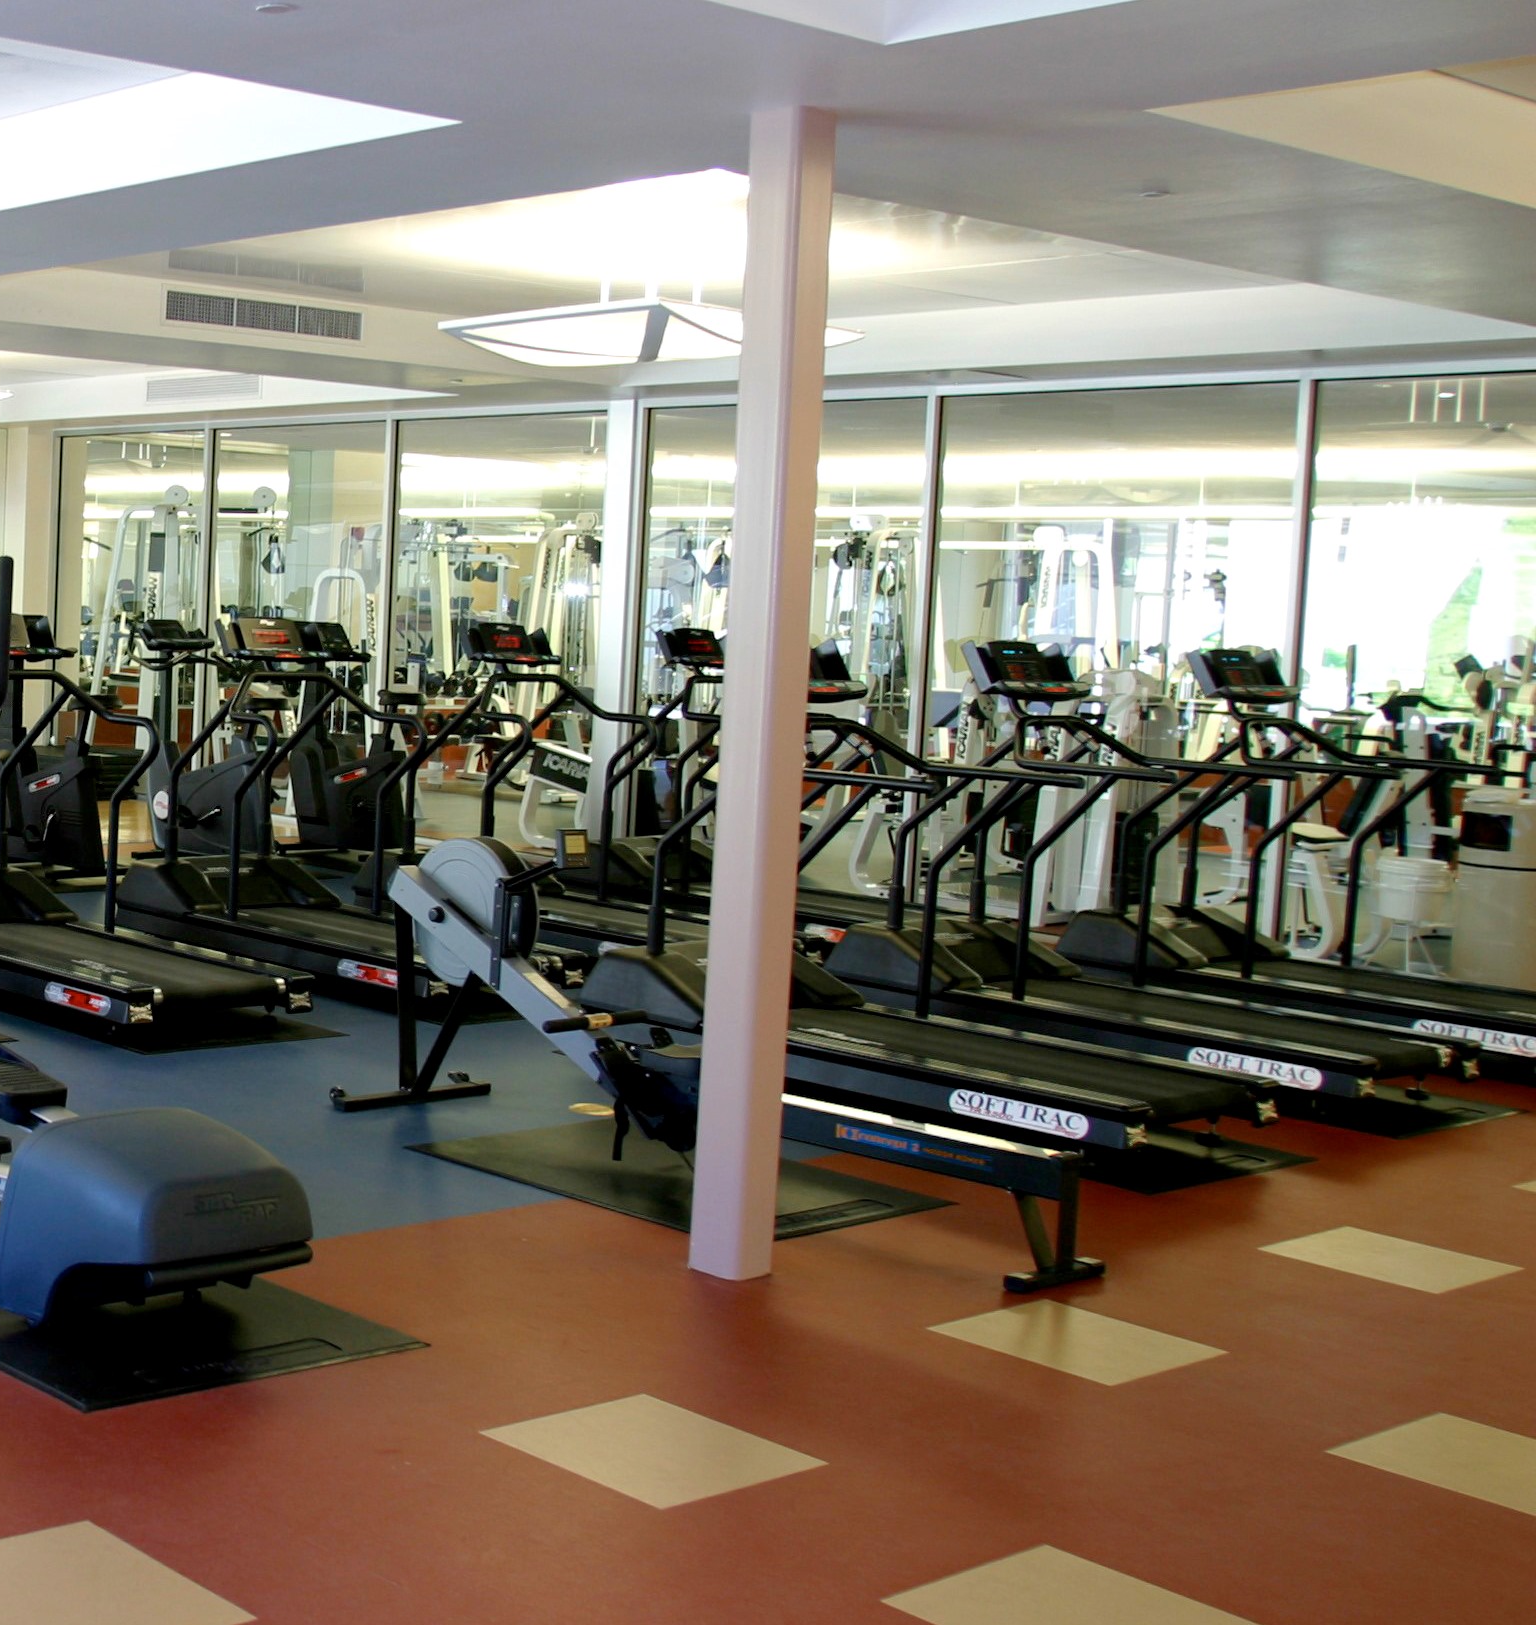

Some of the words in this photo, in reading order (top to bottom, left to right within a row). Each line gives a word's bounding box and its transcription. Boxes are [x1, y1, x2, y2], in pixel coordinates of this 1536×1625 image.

[147, 576, 157, 620] CARIAN
[1420, 1021, 1476, 1039] SOFT
[1193, 1048, 1250, 1071] SOFT
[1255, 1059, 1316, 1083] TRAC
[955, 1089, 1013, 1117] SOFT
[1018, 1103, 1083, 1131] TRAC
